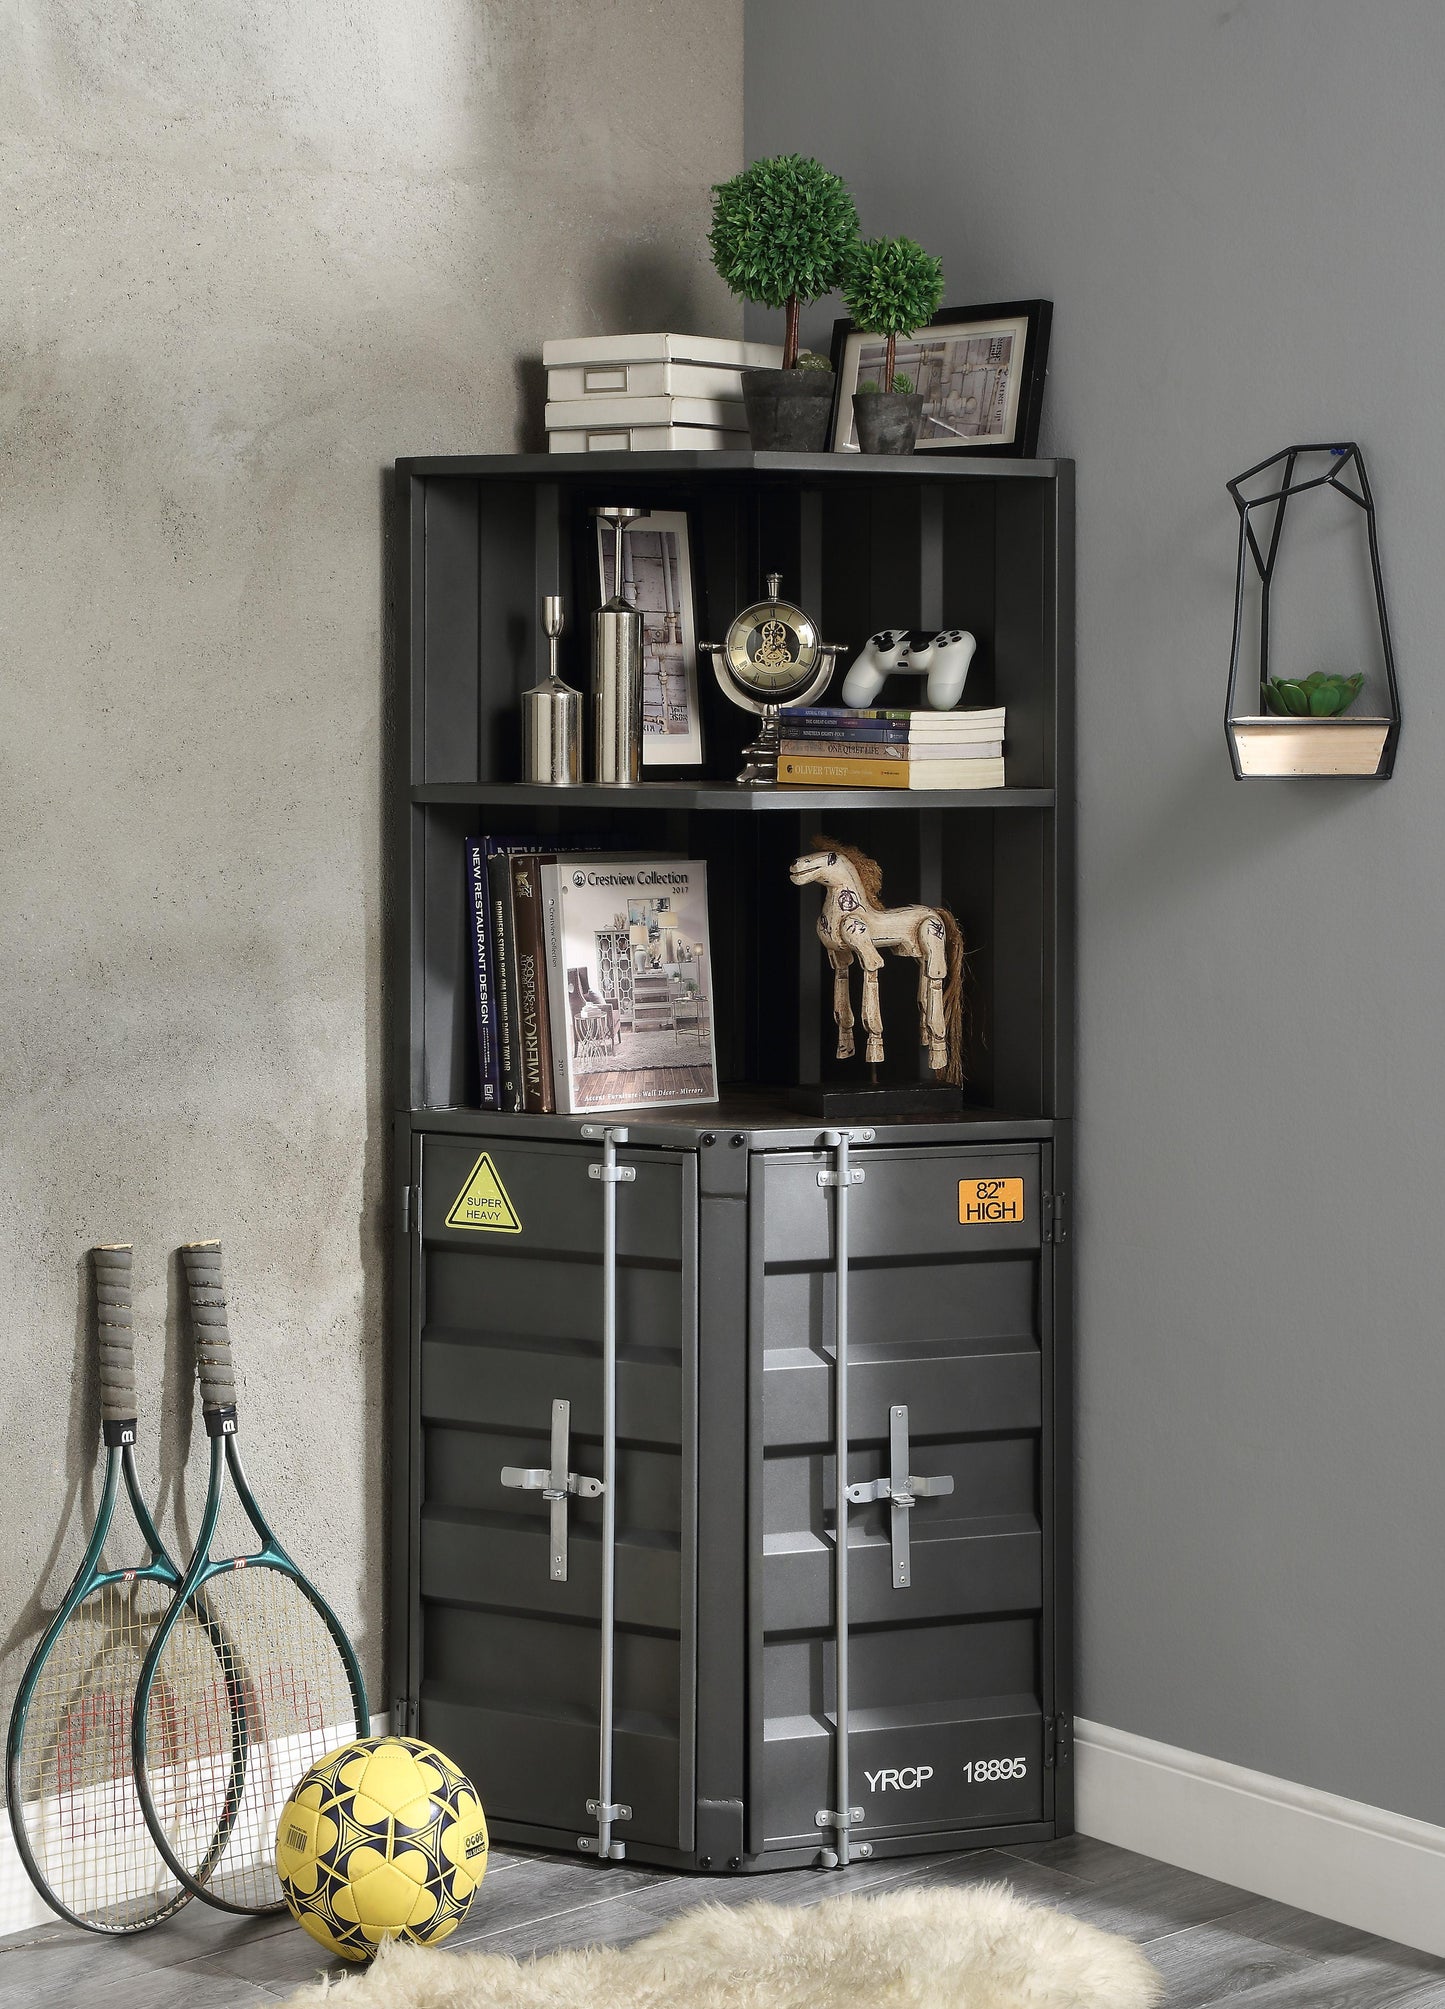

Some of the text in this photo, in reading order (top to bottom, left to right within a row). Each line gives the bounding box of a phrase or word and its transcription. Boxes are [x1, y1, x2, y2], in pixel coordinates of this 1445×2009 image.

[795, 764, 823, 776] OLIVER
[824, 765, 849, 777] TWIST
[472, 847, 482, 880] NEW
[587, 870, 688, 886] Crestview Collection
[672, 886, 689, 894] 2017
[474, 882, 487, 970] RESTAURANT
[479, 974, 489, 1024] DESIGN
[976, 1181, 1006, 1200] 82"
[466, 1196, 502, 1208] SUPER
[966, 1201, 1017, 1221] HIGH
[466, 1209, 501, 1221] HEAVY
[863, 1757, 1027, 1793] YRCP 18895
